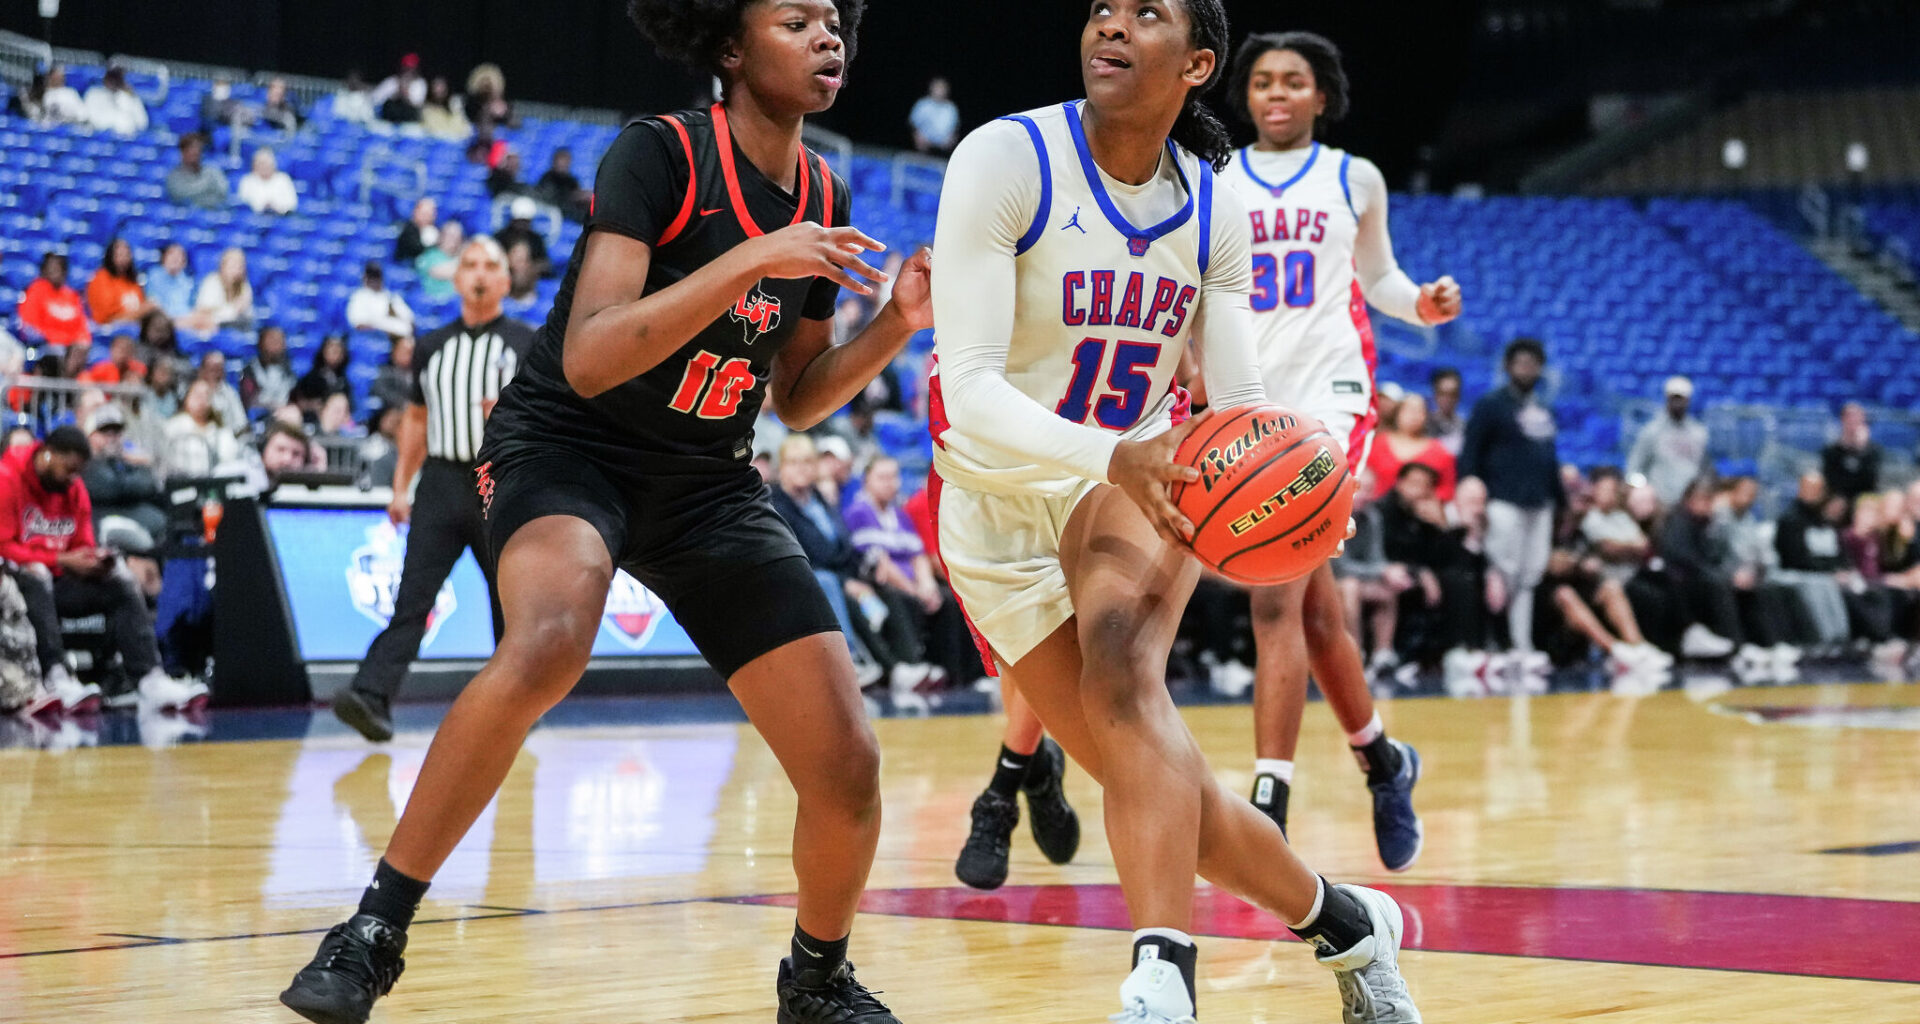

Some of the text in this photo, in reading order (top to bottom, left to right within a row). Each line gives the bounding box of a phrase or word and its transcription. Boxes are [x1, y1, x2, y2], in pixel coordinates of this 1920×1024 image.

[1250, 208, 1329, 243] HAPS
[1063, 270, 1198, 337] CHAPS
[1250, 249, 1315, 313] 30
[667, 349, 756, 419] 10
[1055, 337, 1162, 431] 15
[1200, 415, 1298, 494] Baden
